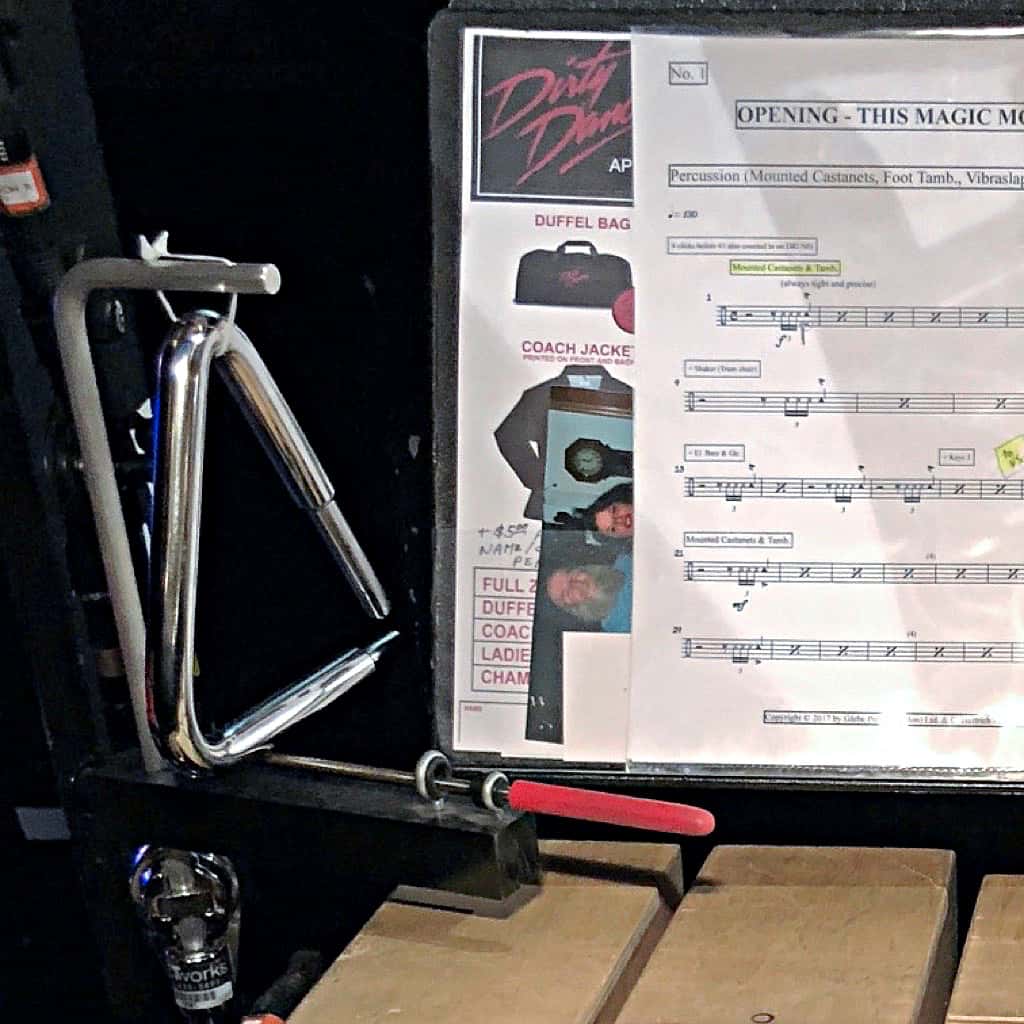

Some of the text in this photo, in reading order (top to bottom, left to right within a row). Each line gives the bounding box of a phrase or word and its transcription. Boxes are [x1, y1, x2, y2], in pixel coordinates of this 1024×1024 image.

[671, 66, 694, 81] No.
[738, 106, 838, 123] OPENING
[857, 107, 909, 124] THIS
[915, 107, 991, 125] MAGIC
[671, 167, 739, 183] Percussion
[744, 169, 808, 185] (Mounted
[812, 170, 880, 185] Castanets,
[883, 171, 912, 184] Foot
[535, 214, 631, 230] DUFFEL BAG
[522, 341, 635, 357] COACH JACKE
[483, 577, 524, 592] FULL
[482, 623, 529, 639] COAC
